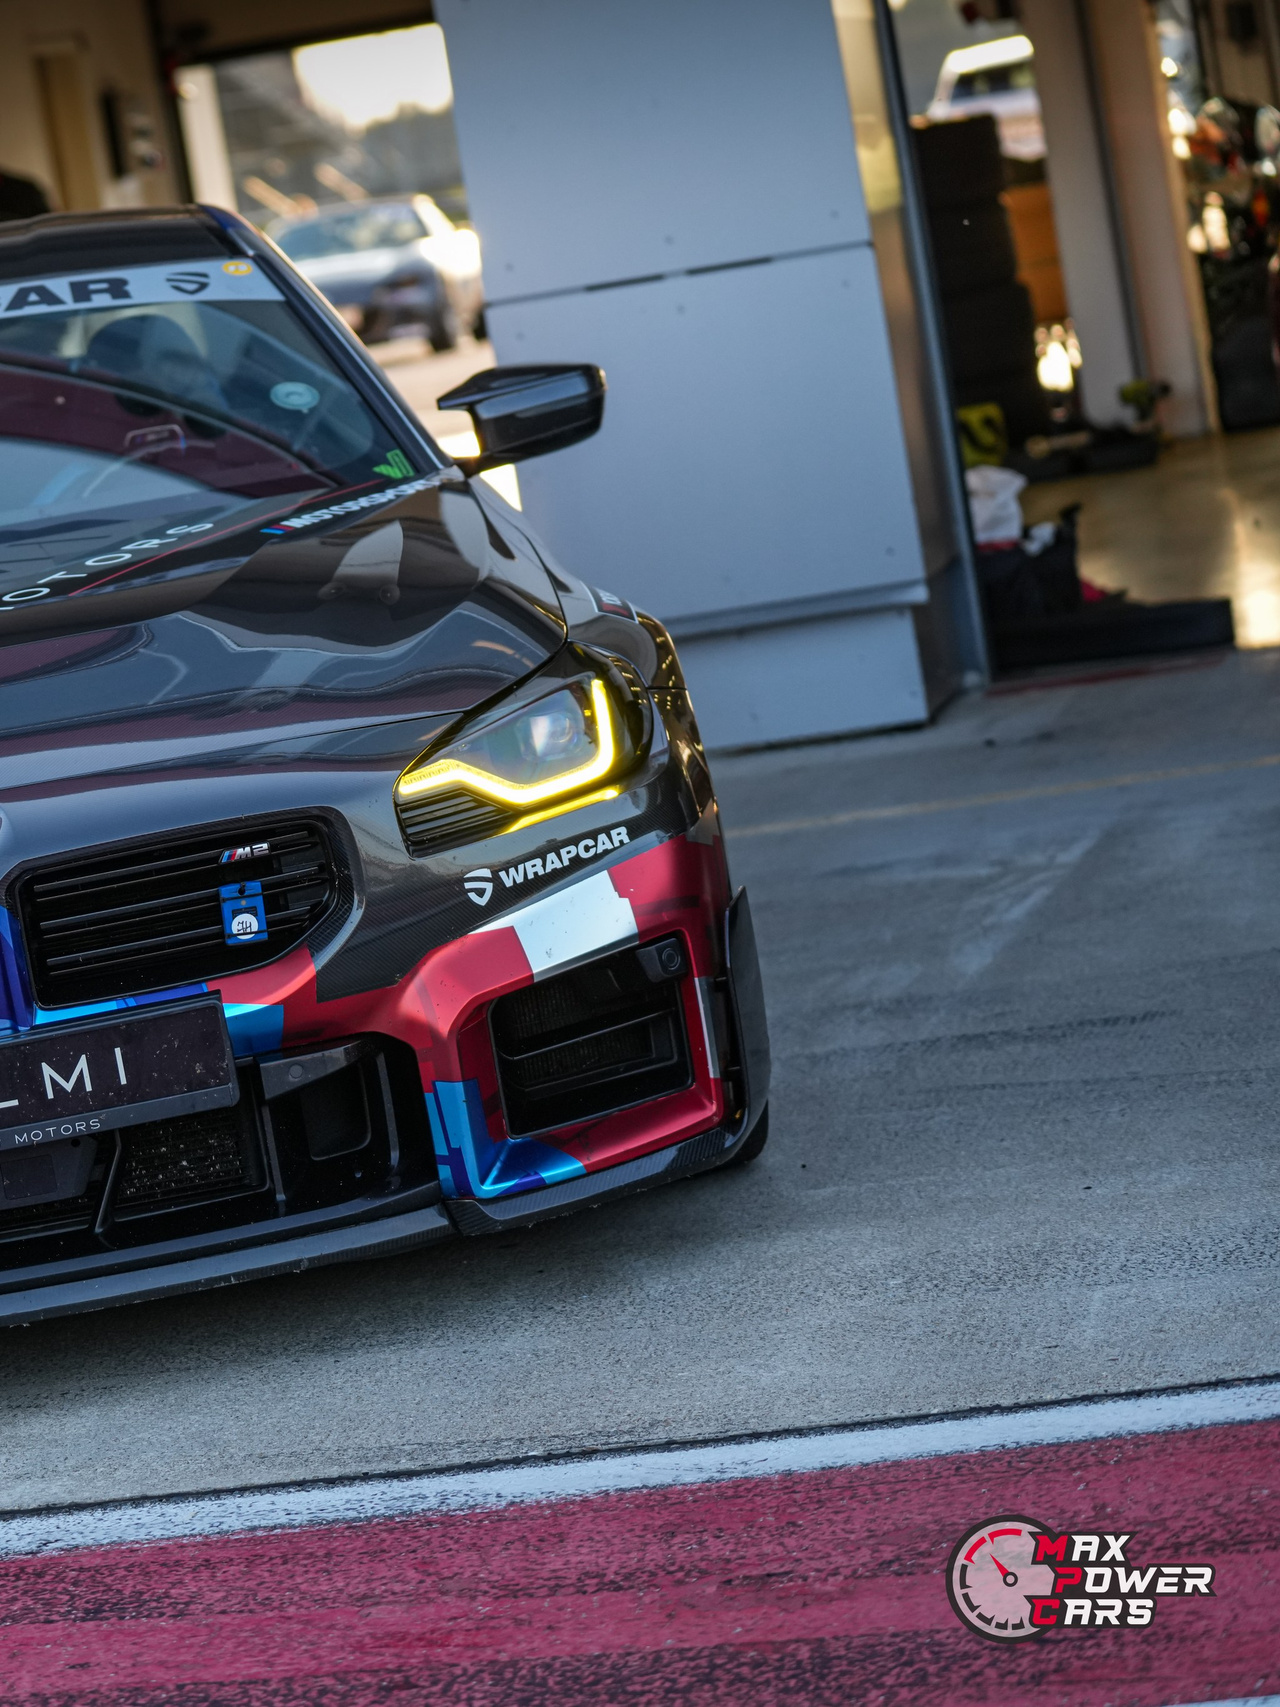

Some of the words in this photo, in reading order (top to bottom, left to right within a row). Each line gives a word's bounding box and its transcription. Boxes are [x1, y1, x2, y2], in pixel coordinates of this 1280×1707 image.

[233, 842, 270, 860] M2
[498, 825, 631, 888] WRAPCAR
[14, 1118, 102, 1145] MOTORS
